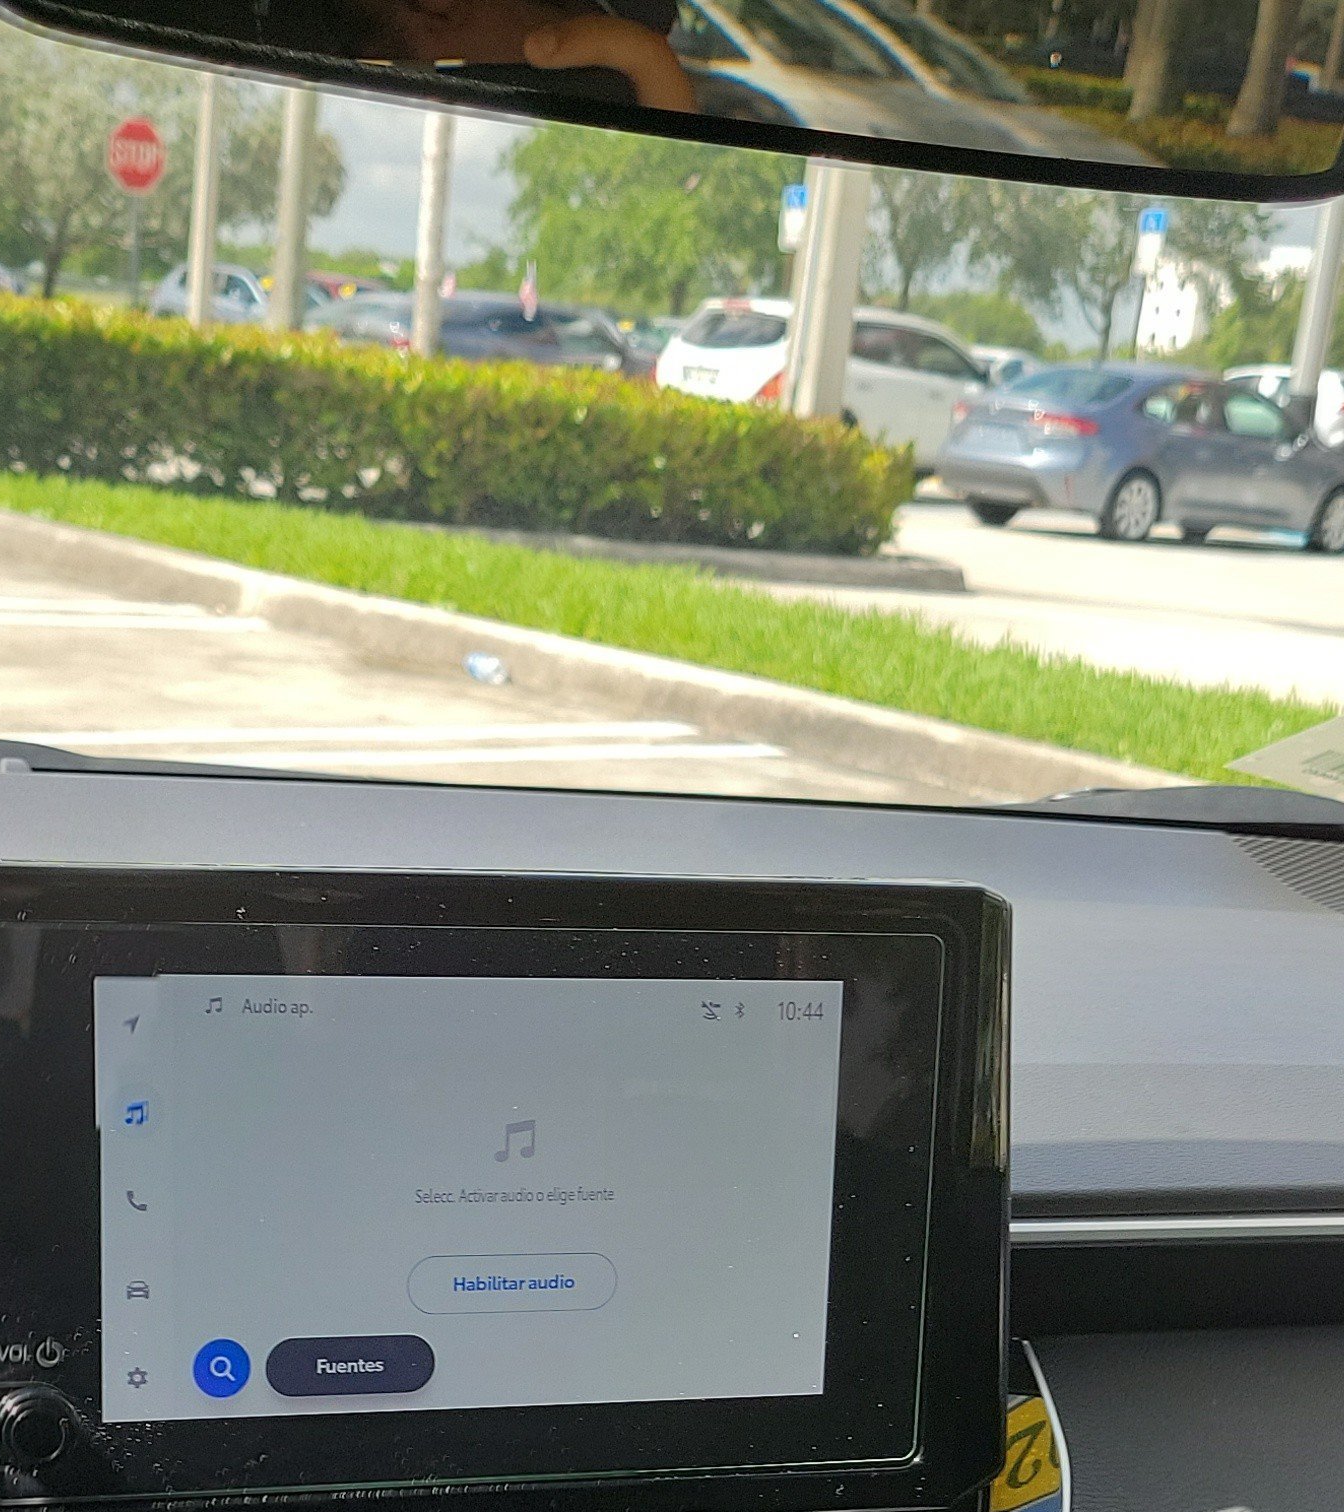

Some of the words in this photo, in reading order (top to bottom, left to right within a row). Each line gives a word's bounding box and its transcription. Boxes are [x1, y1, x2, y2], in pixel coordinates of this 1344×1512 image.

[112, 138, 160, 169] STOP
[242, 998, 287, 1014] Audio
[291, 1003, 313, 1018] ap.
[778, 1001, 824, 1020] 10:44
[459, 1189, 501, 1203] Activar
[501, 1187, 534, 1202] audio
[536, 1190, 545, 1202] o
[547, 1187, 575, 1206] elige
[577, 1186, 615, 1201] fuente
[453, 1276, 526, 1292] Habilitar
[528, 1274, 575, 1290] audio
[316, 1359, 384, 1375] Fuentes
